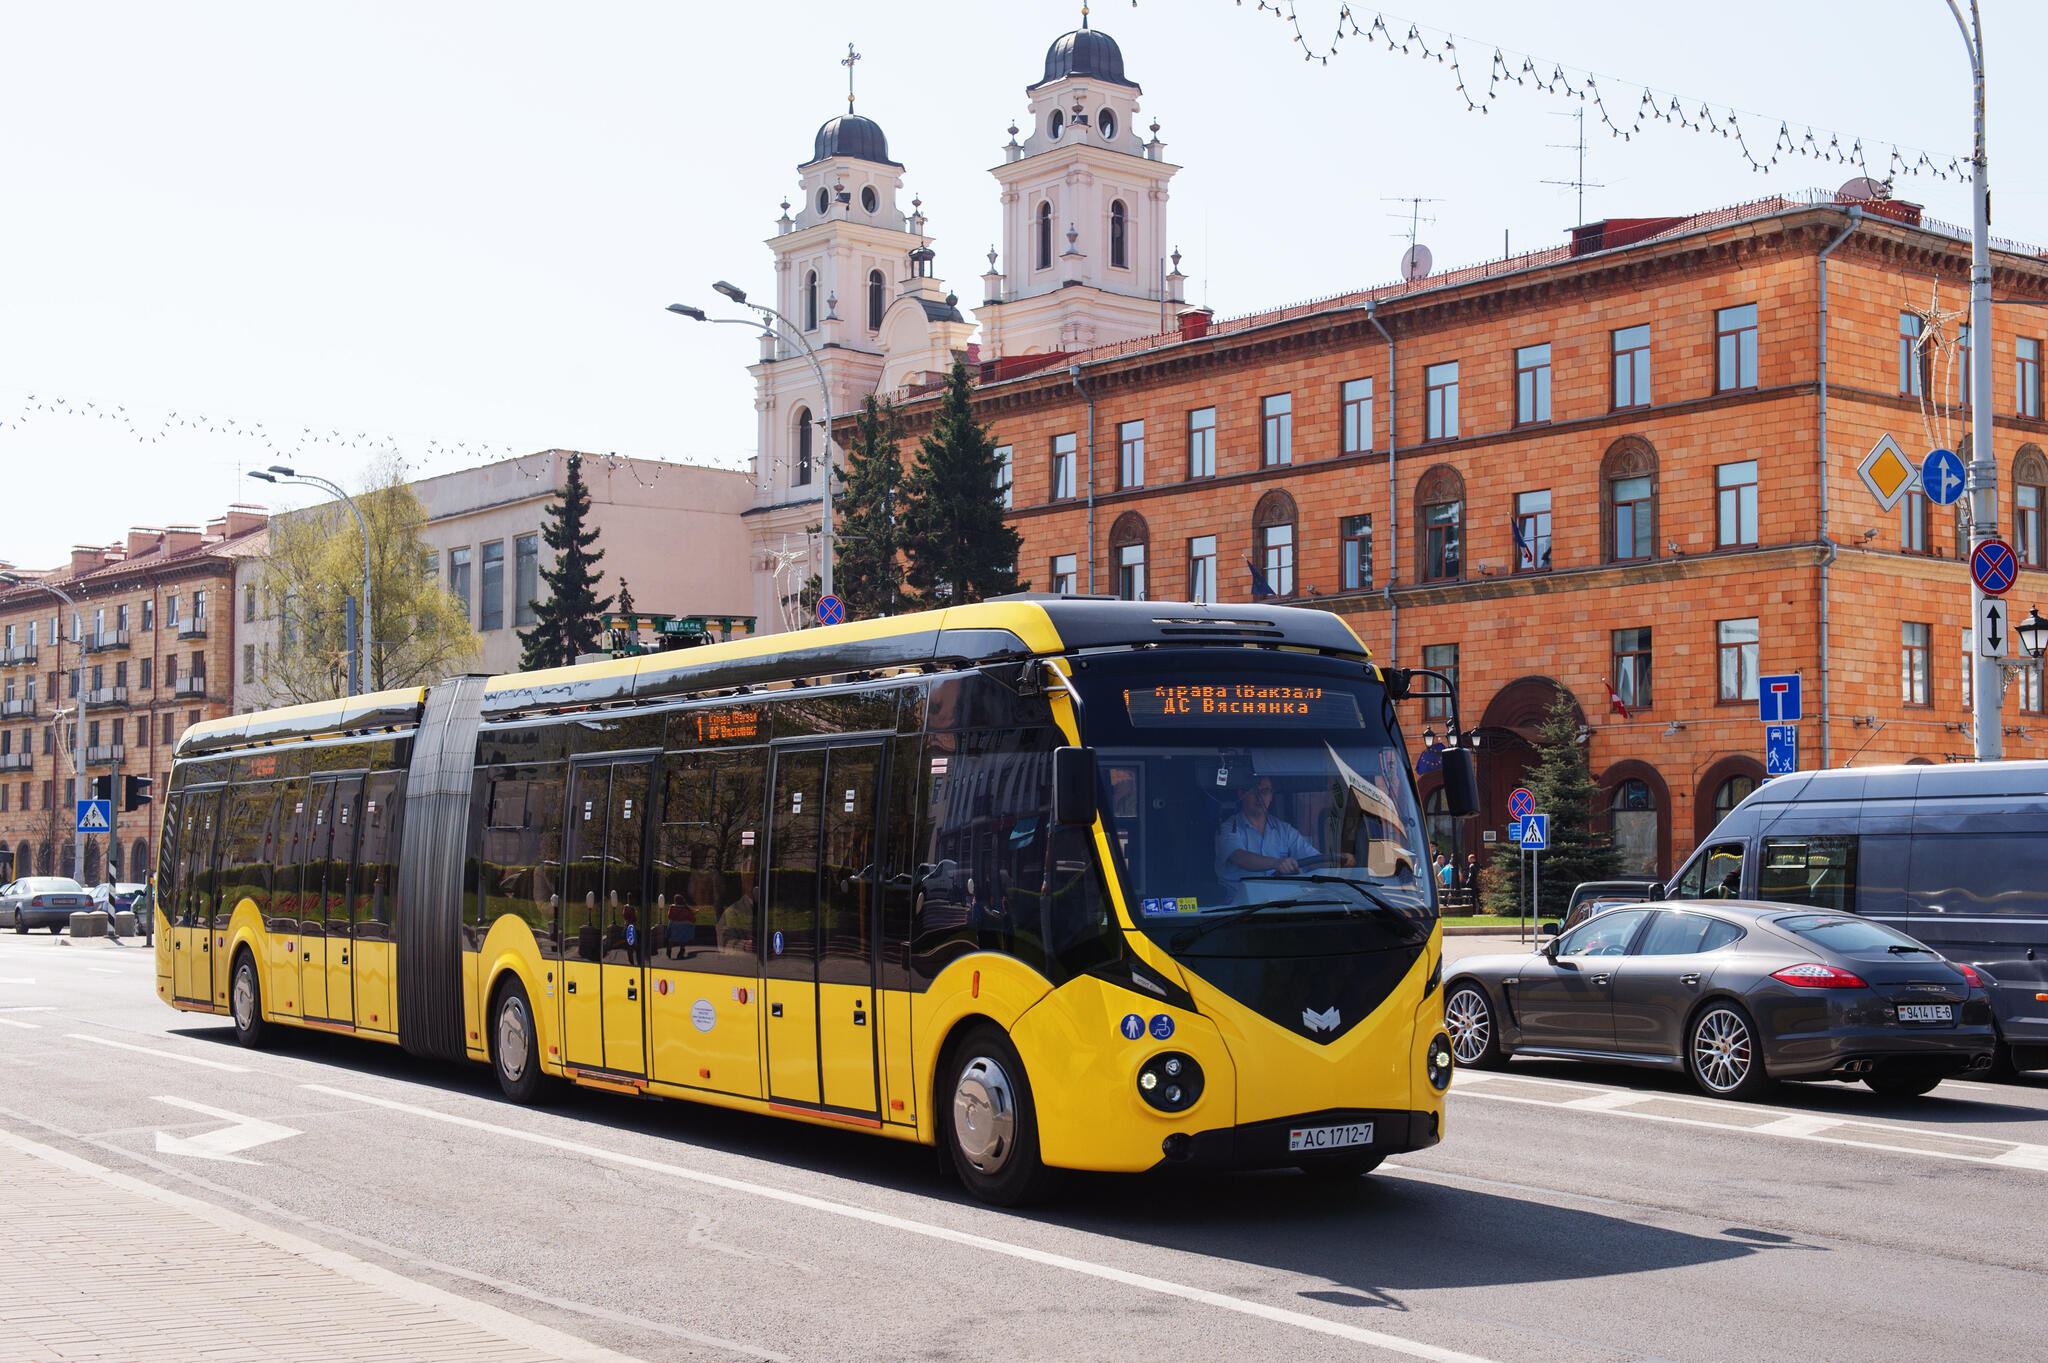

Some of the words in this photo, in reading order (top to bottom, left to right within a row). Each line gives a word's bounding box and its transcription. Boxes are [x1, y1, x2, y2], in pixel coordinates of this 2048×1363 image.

[1164, 697, 1190, 714] ДС
[1203, 698, 1309, 713] Вяснянка
[1303, 1129, 1326, 1148] AC
[1330, 1124, 1372, 1145] 1712-7
